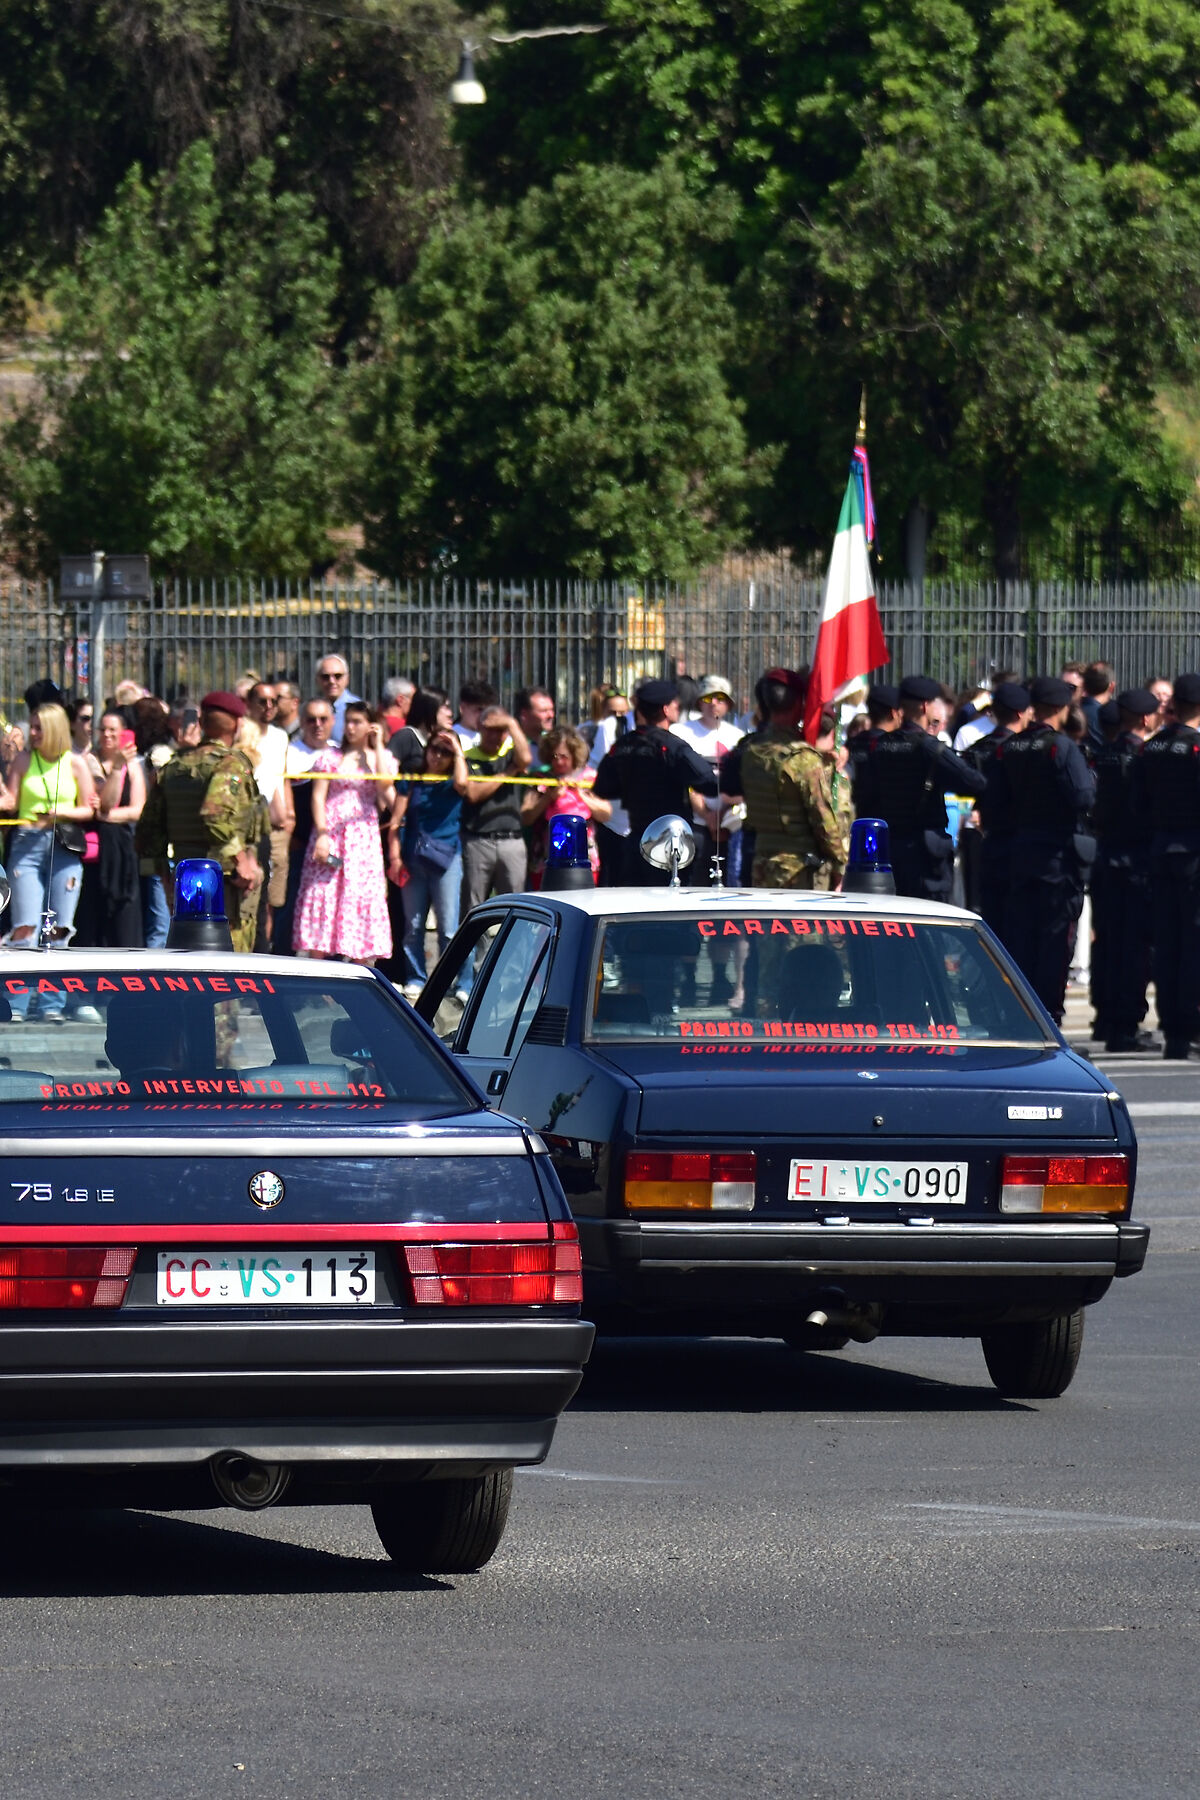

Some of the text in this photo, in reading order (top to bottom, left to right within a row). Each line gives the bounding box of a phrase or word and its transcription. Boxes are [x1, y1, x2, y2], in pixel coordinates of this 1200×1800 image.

[697, 919, 916, 938] CARABINIERI
[4, 976, 276, 995] CARABINIERI
[679, 1022, 960, 1040] PRONTO INTERVENTO TEL.112
[39, 1079, 386, 1098] PRONTO INTERVENTO TEL.112
[795, 1165, 961, 1198] EI VS 090
[10, 1183, 53, 1202] 75
[166, 1257, 368, 1298] CC VS 113
